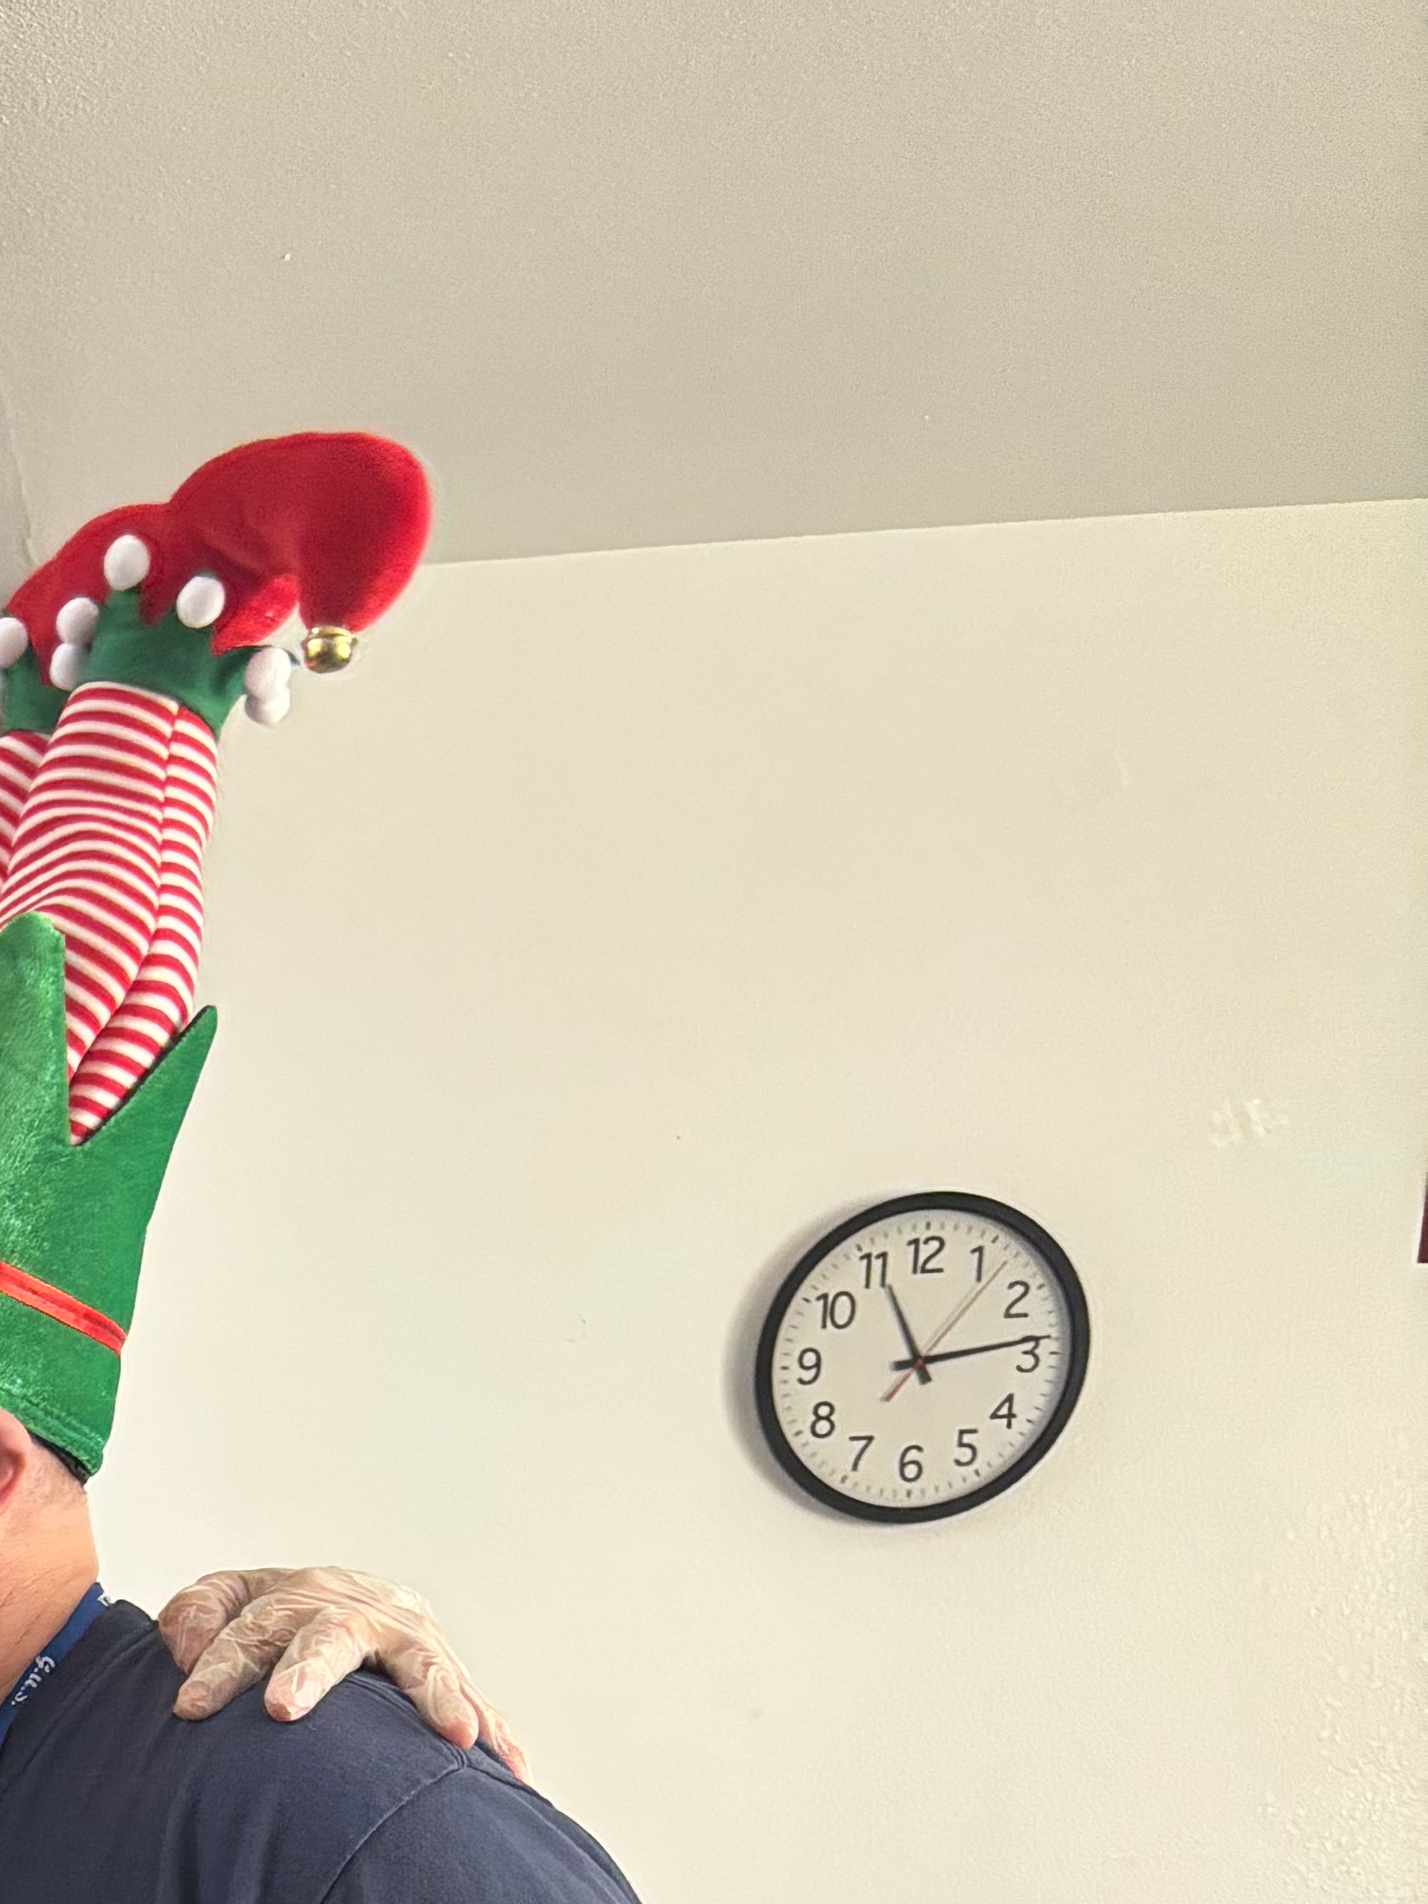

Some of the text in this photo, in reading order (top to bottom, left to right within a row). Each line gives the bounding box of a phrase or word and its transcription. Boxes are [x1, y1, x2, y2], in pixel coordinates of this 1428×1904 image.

[859, 1252, 889, 1289] 11
[907, 1235, 945, 1274] 12
[971, 1246, 983, 1282] 1
[816, 1291, 856, 1329] 10
[1004, 1281, 1029, 1318] 2
[798, 1347, 821, 1385] 9
[1016, 1336, 1040, 1373] 3
[811, 1401, 835, 1438] 8
[990, 1393, 1016, 1429] 4
[849, 1436, 874, 1472] 7
[899, 1445, 923, 1482] 6
[954, 1429, 978, 1467] 5
